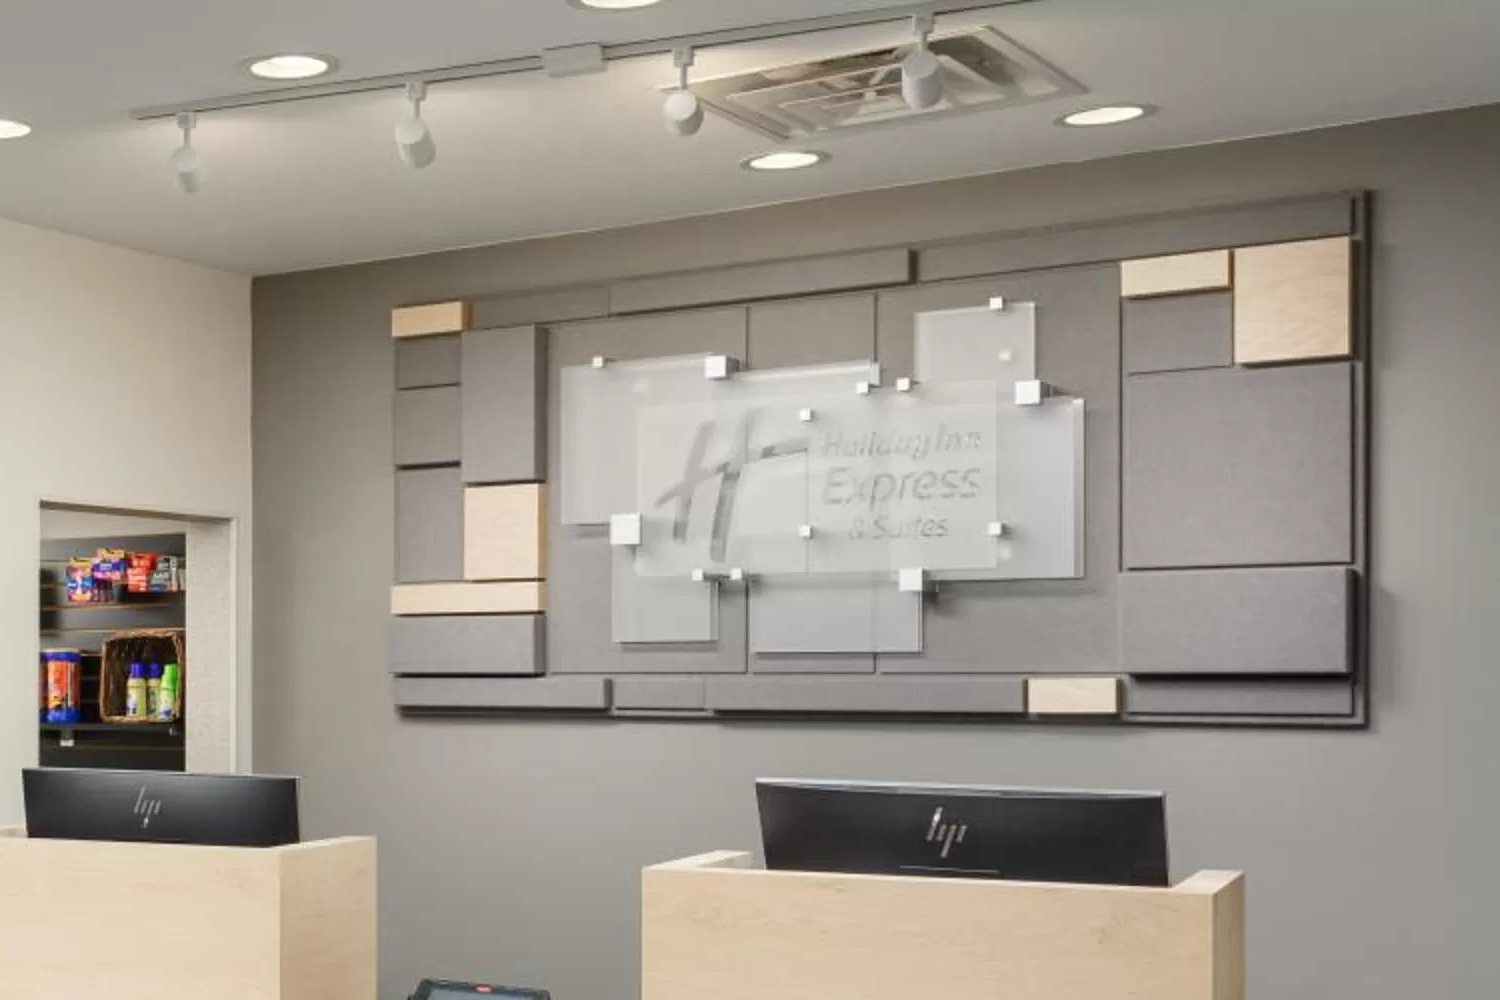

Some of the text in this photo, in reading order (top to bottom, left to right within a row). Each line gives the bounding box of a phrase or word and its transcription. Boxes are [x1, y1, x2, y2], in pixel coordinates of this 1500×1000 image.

[821, 423, 981, 460] Holiday Inn
[821, 466, 981, 513] Express
[847, 513, 950, 542] & Suites
[133, 783, 162, 829] hp
[926, 806, 968, 859] hp
